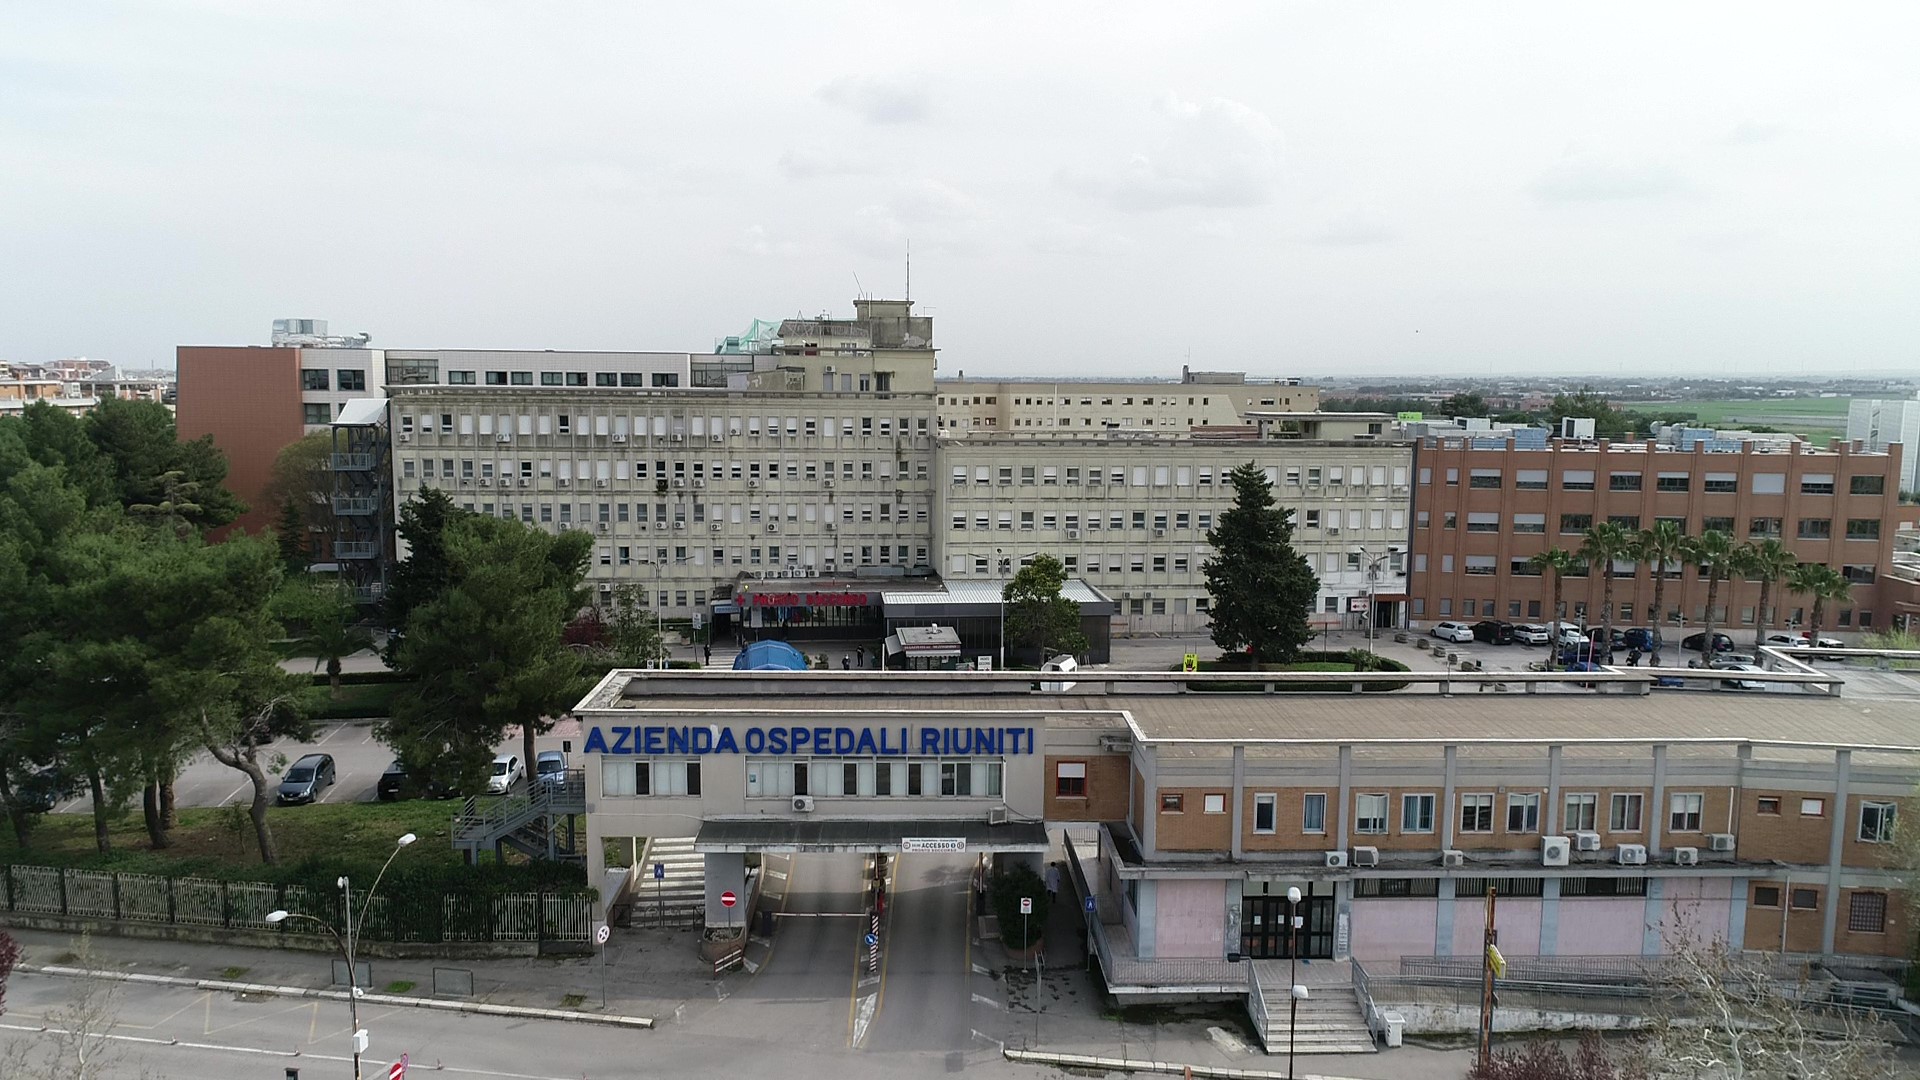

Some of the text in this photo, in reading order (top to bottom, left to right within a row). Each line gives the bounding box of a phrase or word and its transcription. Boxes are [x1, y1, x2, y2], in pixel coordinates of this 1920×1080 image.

[584, 726, 1034, 755] AZIENDA OSPEDALI RIUNITI
